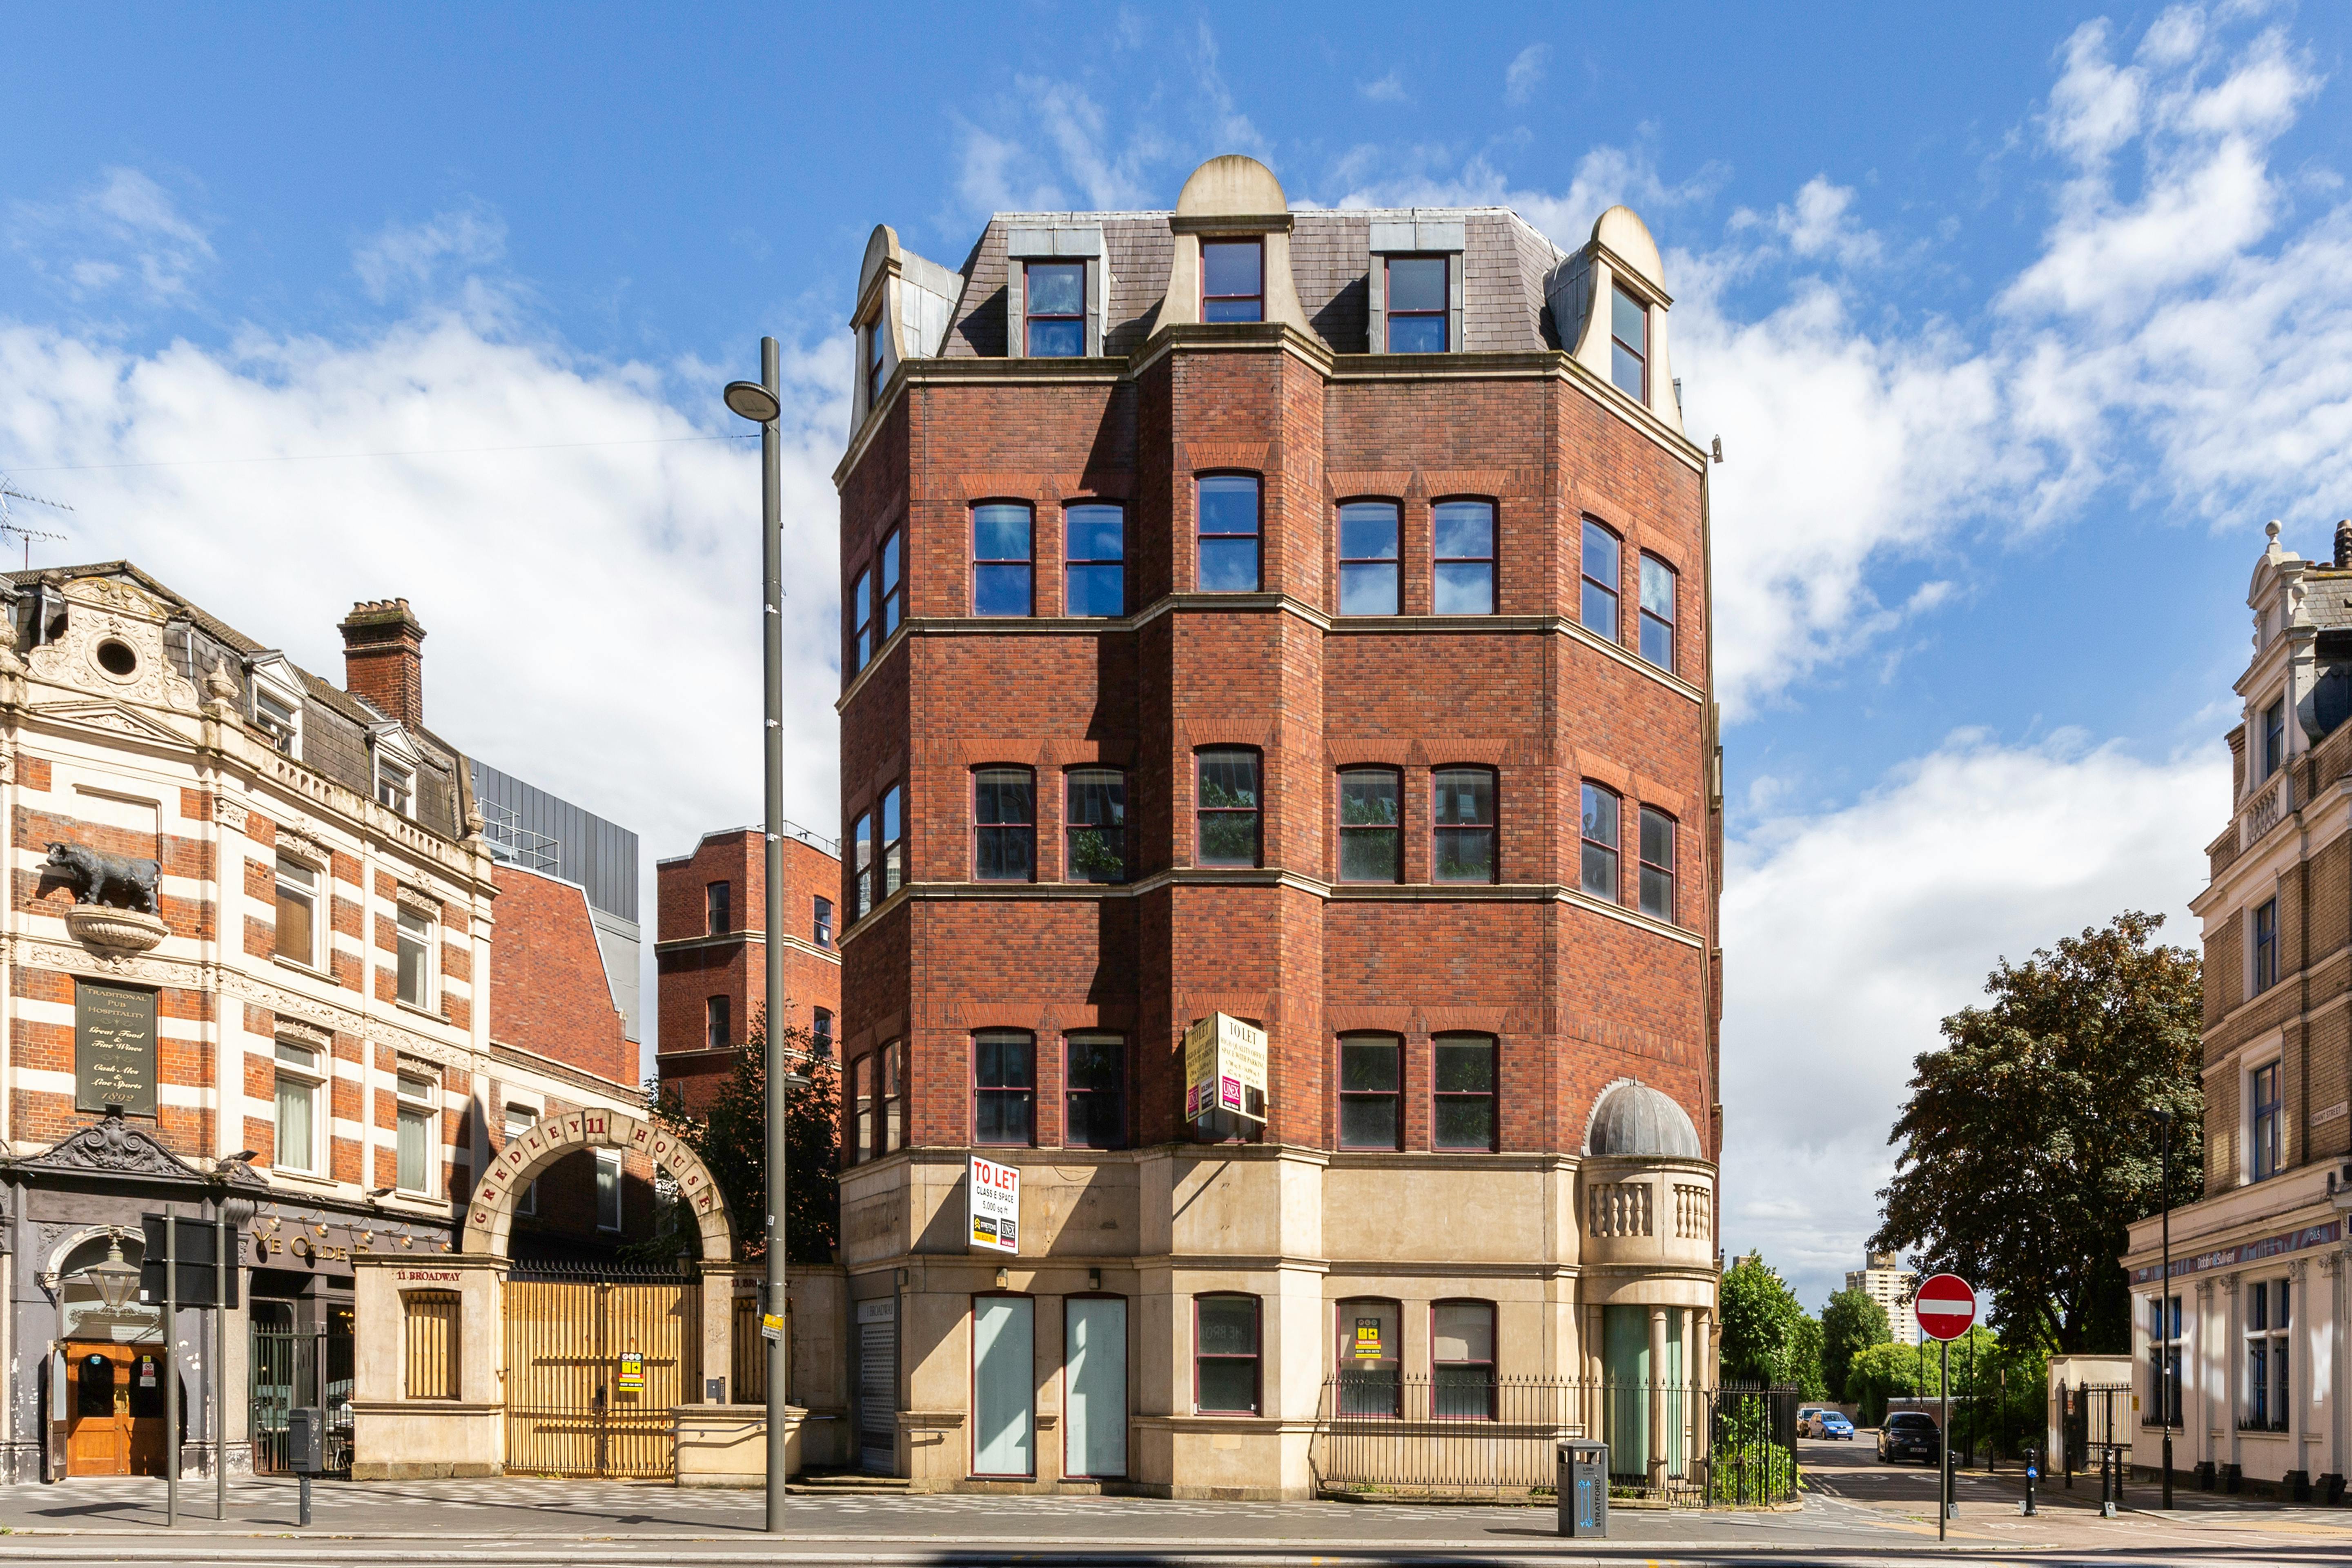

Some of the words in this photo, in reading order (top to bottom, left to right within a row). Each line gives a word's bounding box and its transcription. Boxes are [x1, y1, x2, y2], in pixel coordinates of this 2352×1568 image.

[86, 988, 147, 1001] TRADITIONAL
[88, 1006, 145, 1018] HOSPITALITY
[89, 1026, 114, 1036] Great
[118, 1030, 145, 1039] Food
[1192, 1030, 1198, 1045] TO
[1199, 1022, 1209, 1040] LET
[1229, 1022, 1240, 1038] TO
[1243, 1027, 1256, 1045] LET
[91, 1040, 114, 1049] Fine
[116, 1042, 143, 1052] Wines
[94, 1064, 116, 1073] Cask
[117, 1067, 139, 1075] Ales
[91, 1078, 112, 1086] Live
[114, 1080, 143, 1089] Sports
[1224, 1082, 1239, 1098] UNEX
[102, 1092, 134, 1102] 1892
[2312, 1112, 2325, 1124] CHANT
[2326, 1106, 2341, 1118] STREET
[475, 1120, 579, 1224] GREDLEY
[587, 1118, 604, 1134] 11
[634, 1128, 711, 1208] HOUSE
[974, 1161, 990, 1184] TO
[995, 1168, 1016, 1191] LET
[977, 1186, 992, 1198] CLASS
[994, 1191, 997, 1199] E
[999, 1192, 1013, 1203] SPACE
[1004, 1206, 1008, 1214] ft
[1002, 1223, 1015, 1236] UNEX
[396, 1271, 405, 1280] 11
[409, 1272, 461, 1281] BROADWAY
